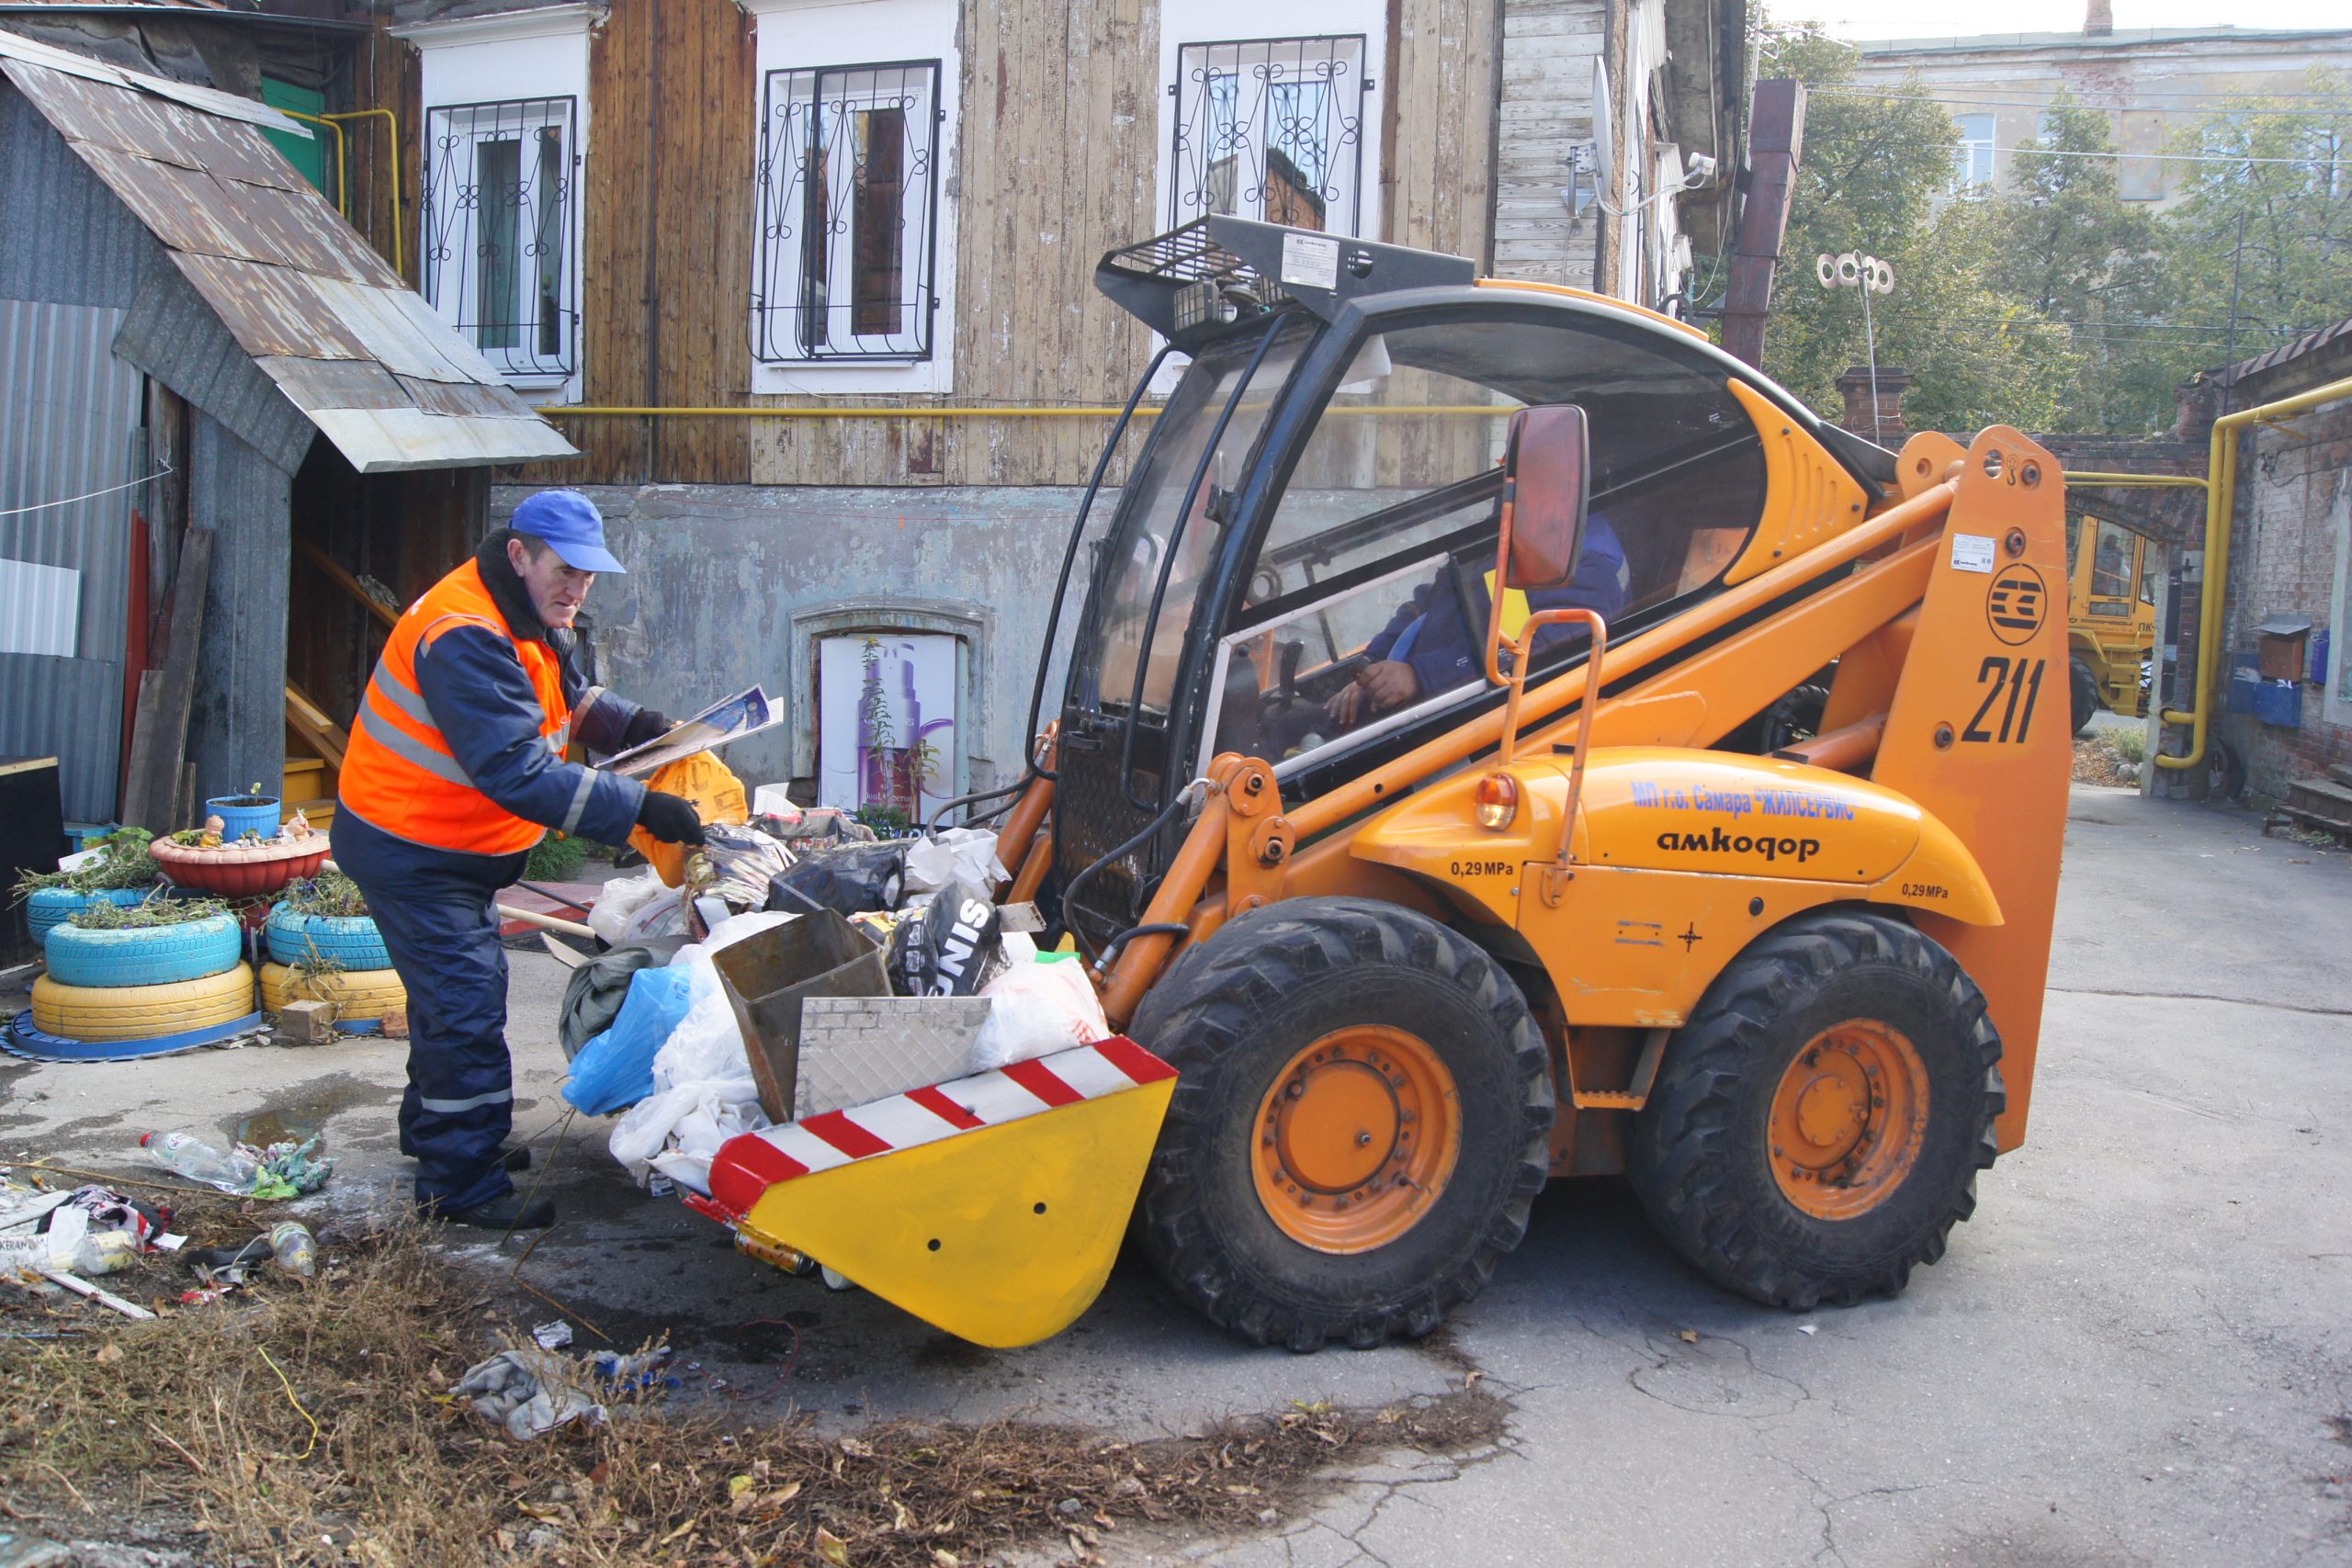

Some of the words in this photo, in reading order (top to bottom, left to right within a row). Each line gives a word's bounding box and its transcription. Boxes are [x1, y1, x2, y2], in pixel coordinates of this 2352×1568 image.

[1961, 656, 2046, 744] 211
[1632, 781, 1660, 808] МП
[1664, 788, 1690, 809] г.о.
[1693, 784, 1752, 819] Самара
[1451, 861, 1482, 878] 0,29
[1485, 862, 1514, 875] MPa
[1902, 883, 1926, 897] 0,29
[1926, 885, 1949, 898] MPa
